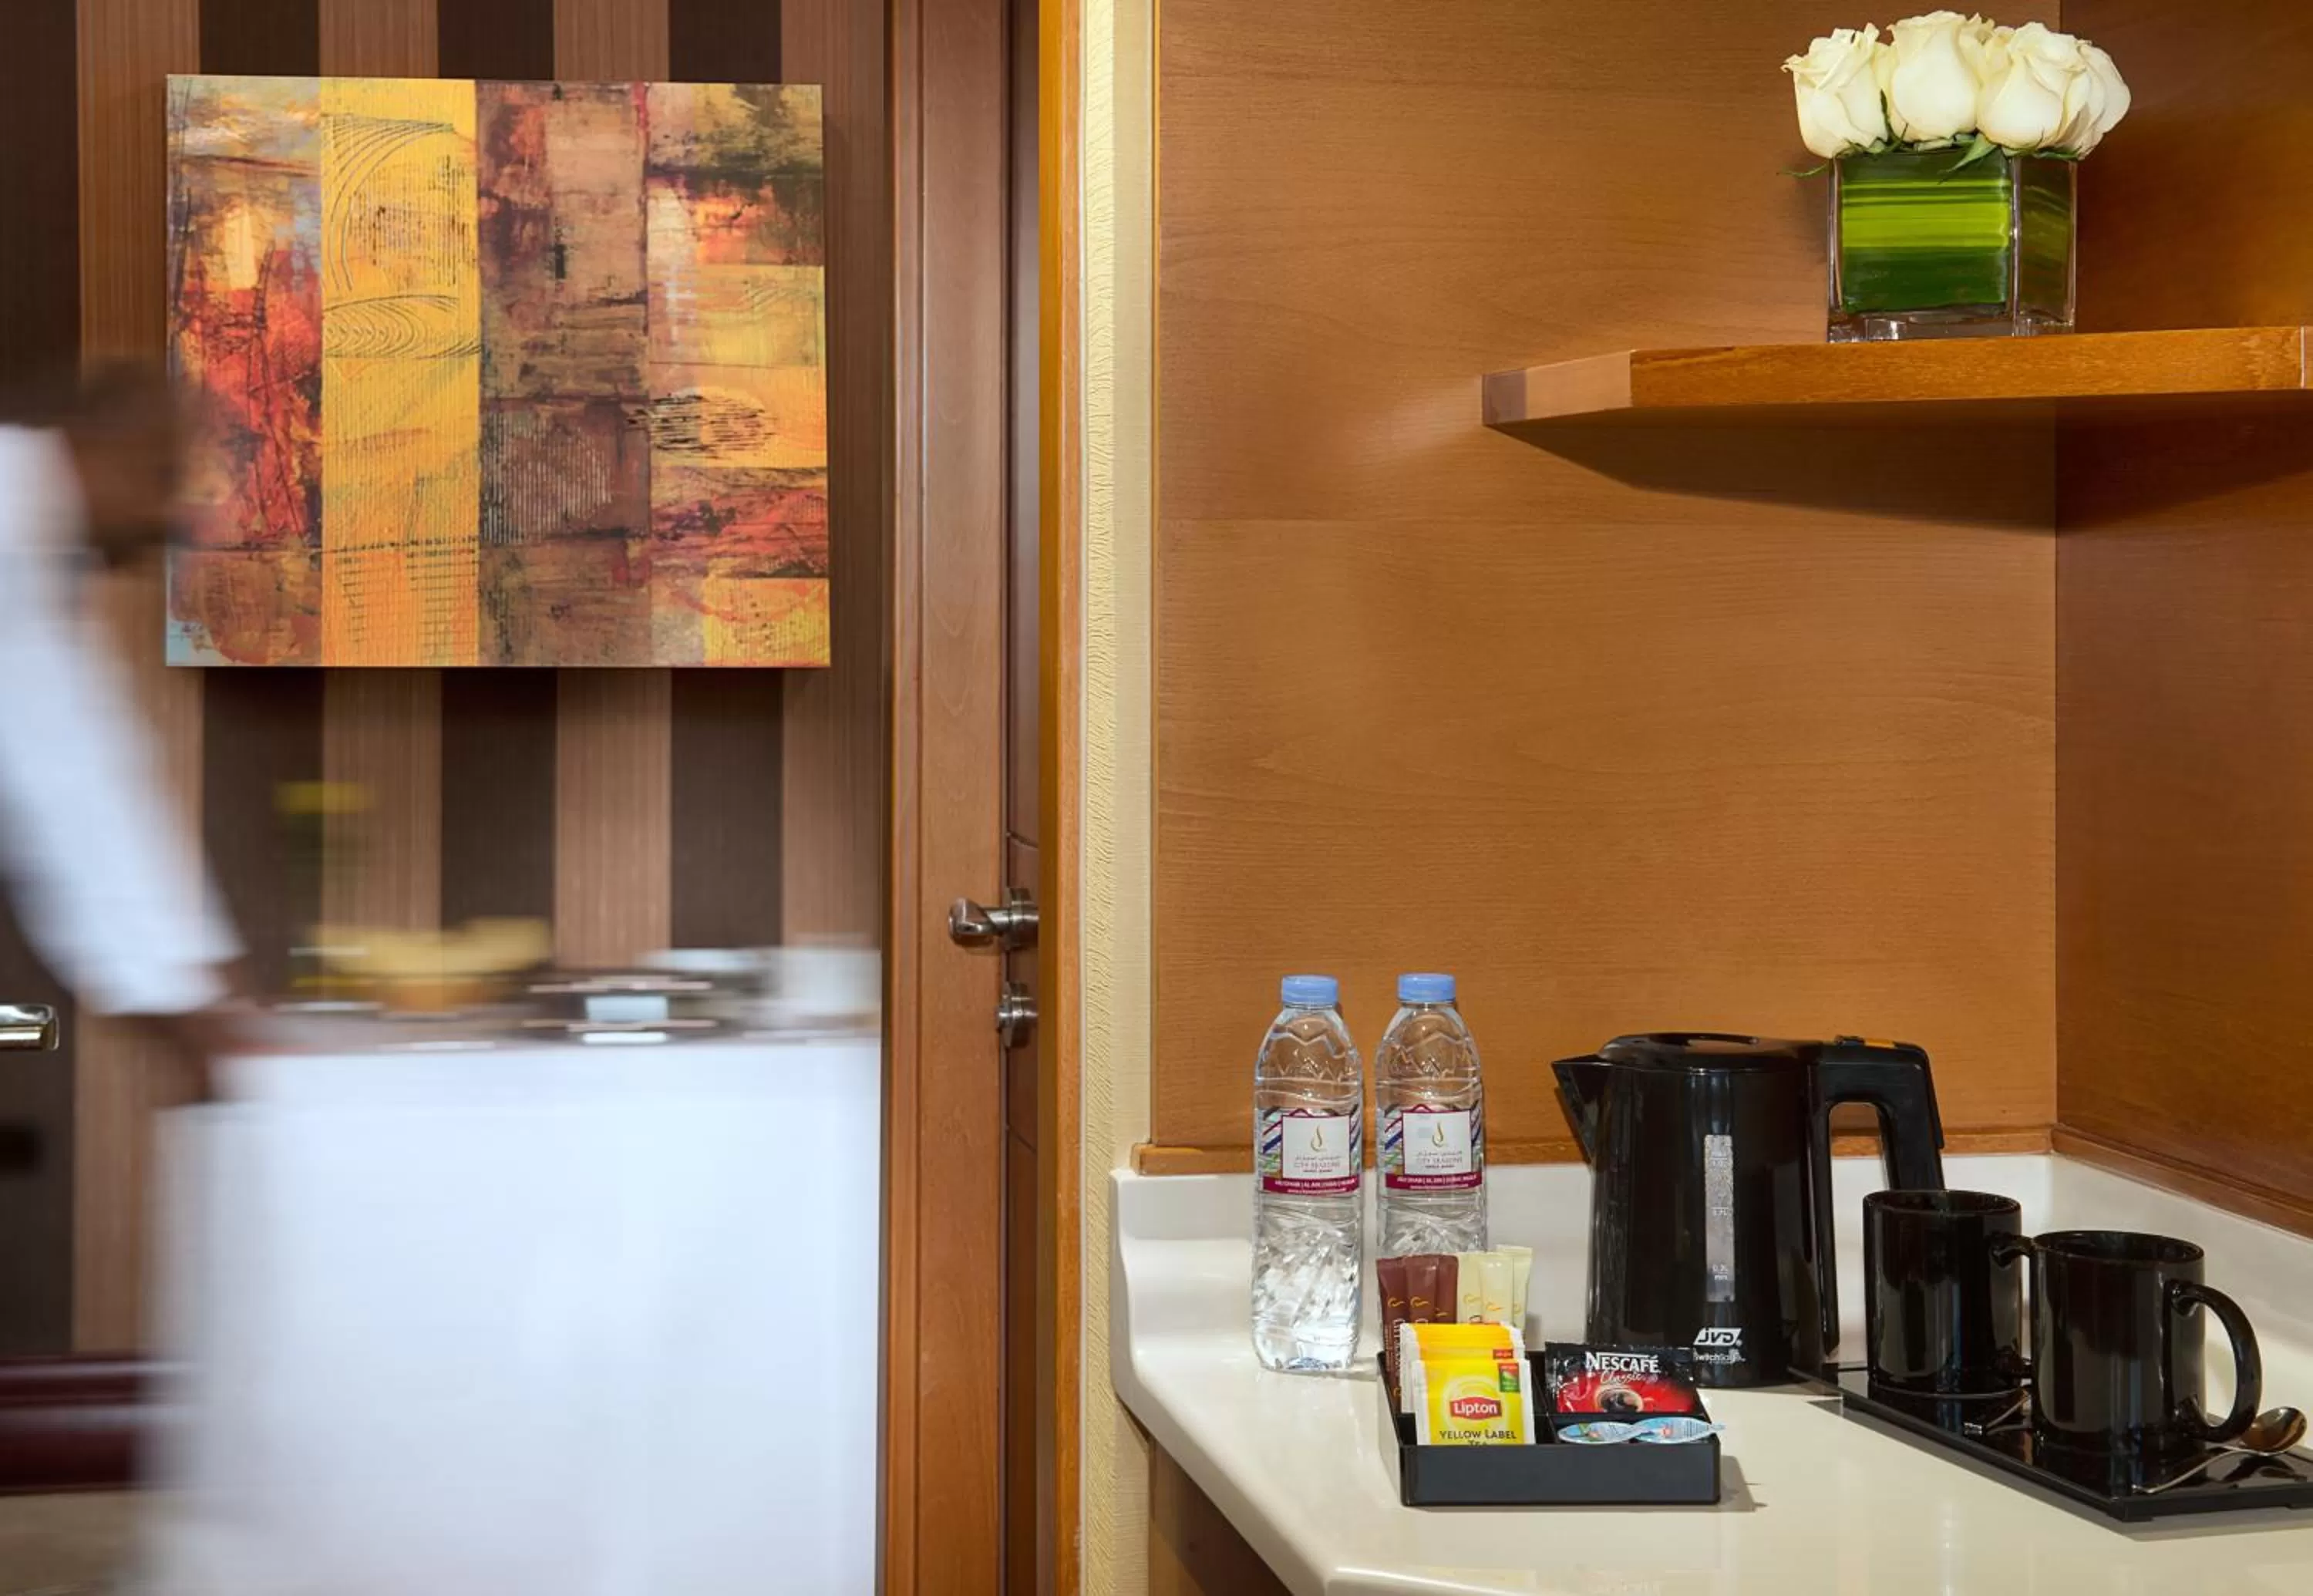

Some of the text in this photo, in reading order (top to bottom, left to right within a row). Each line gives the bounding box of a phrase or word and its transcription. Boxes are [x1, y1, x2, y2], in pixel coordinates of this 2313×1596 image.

[1584, 1351, 1662, 1374] NESCAFÉ
[1453, 1400, 1498, 1416] Lipton
[1439, 1428, 1517, 1440] YELLOW LABEL
